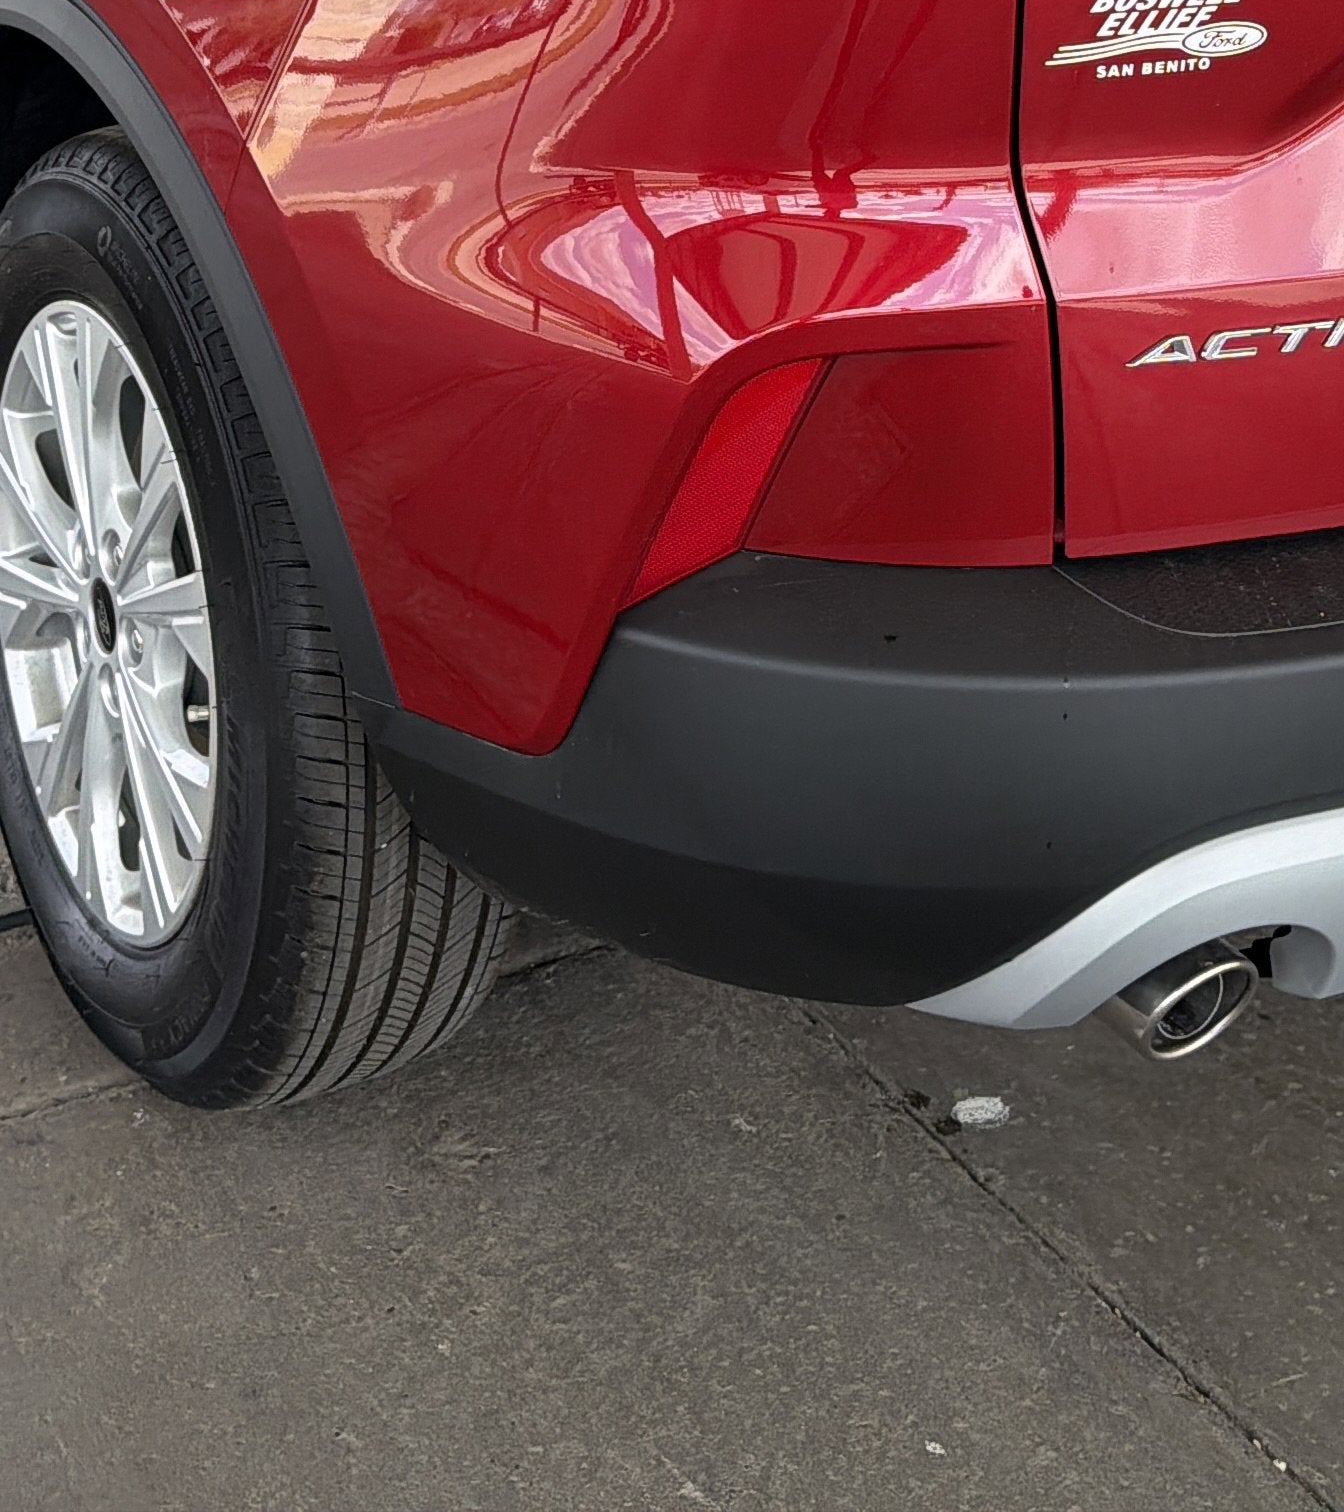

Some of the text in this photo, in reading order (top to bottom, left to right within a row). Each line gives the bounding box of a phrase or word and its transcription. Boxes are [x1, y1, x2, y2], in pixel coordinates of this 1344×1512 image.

[1096, 6, 1218, 37] ELLIFF
[1198, 29, 1247, 49] Ford
[1096, 57, 1211, 79] SAN BENITO
